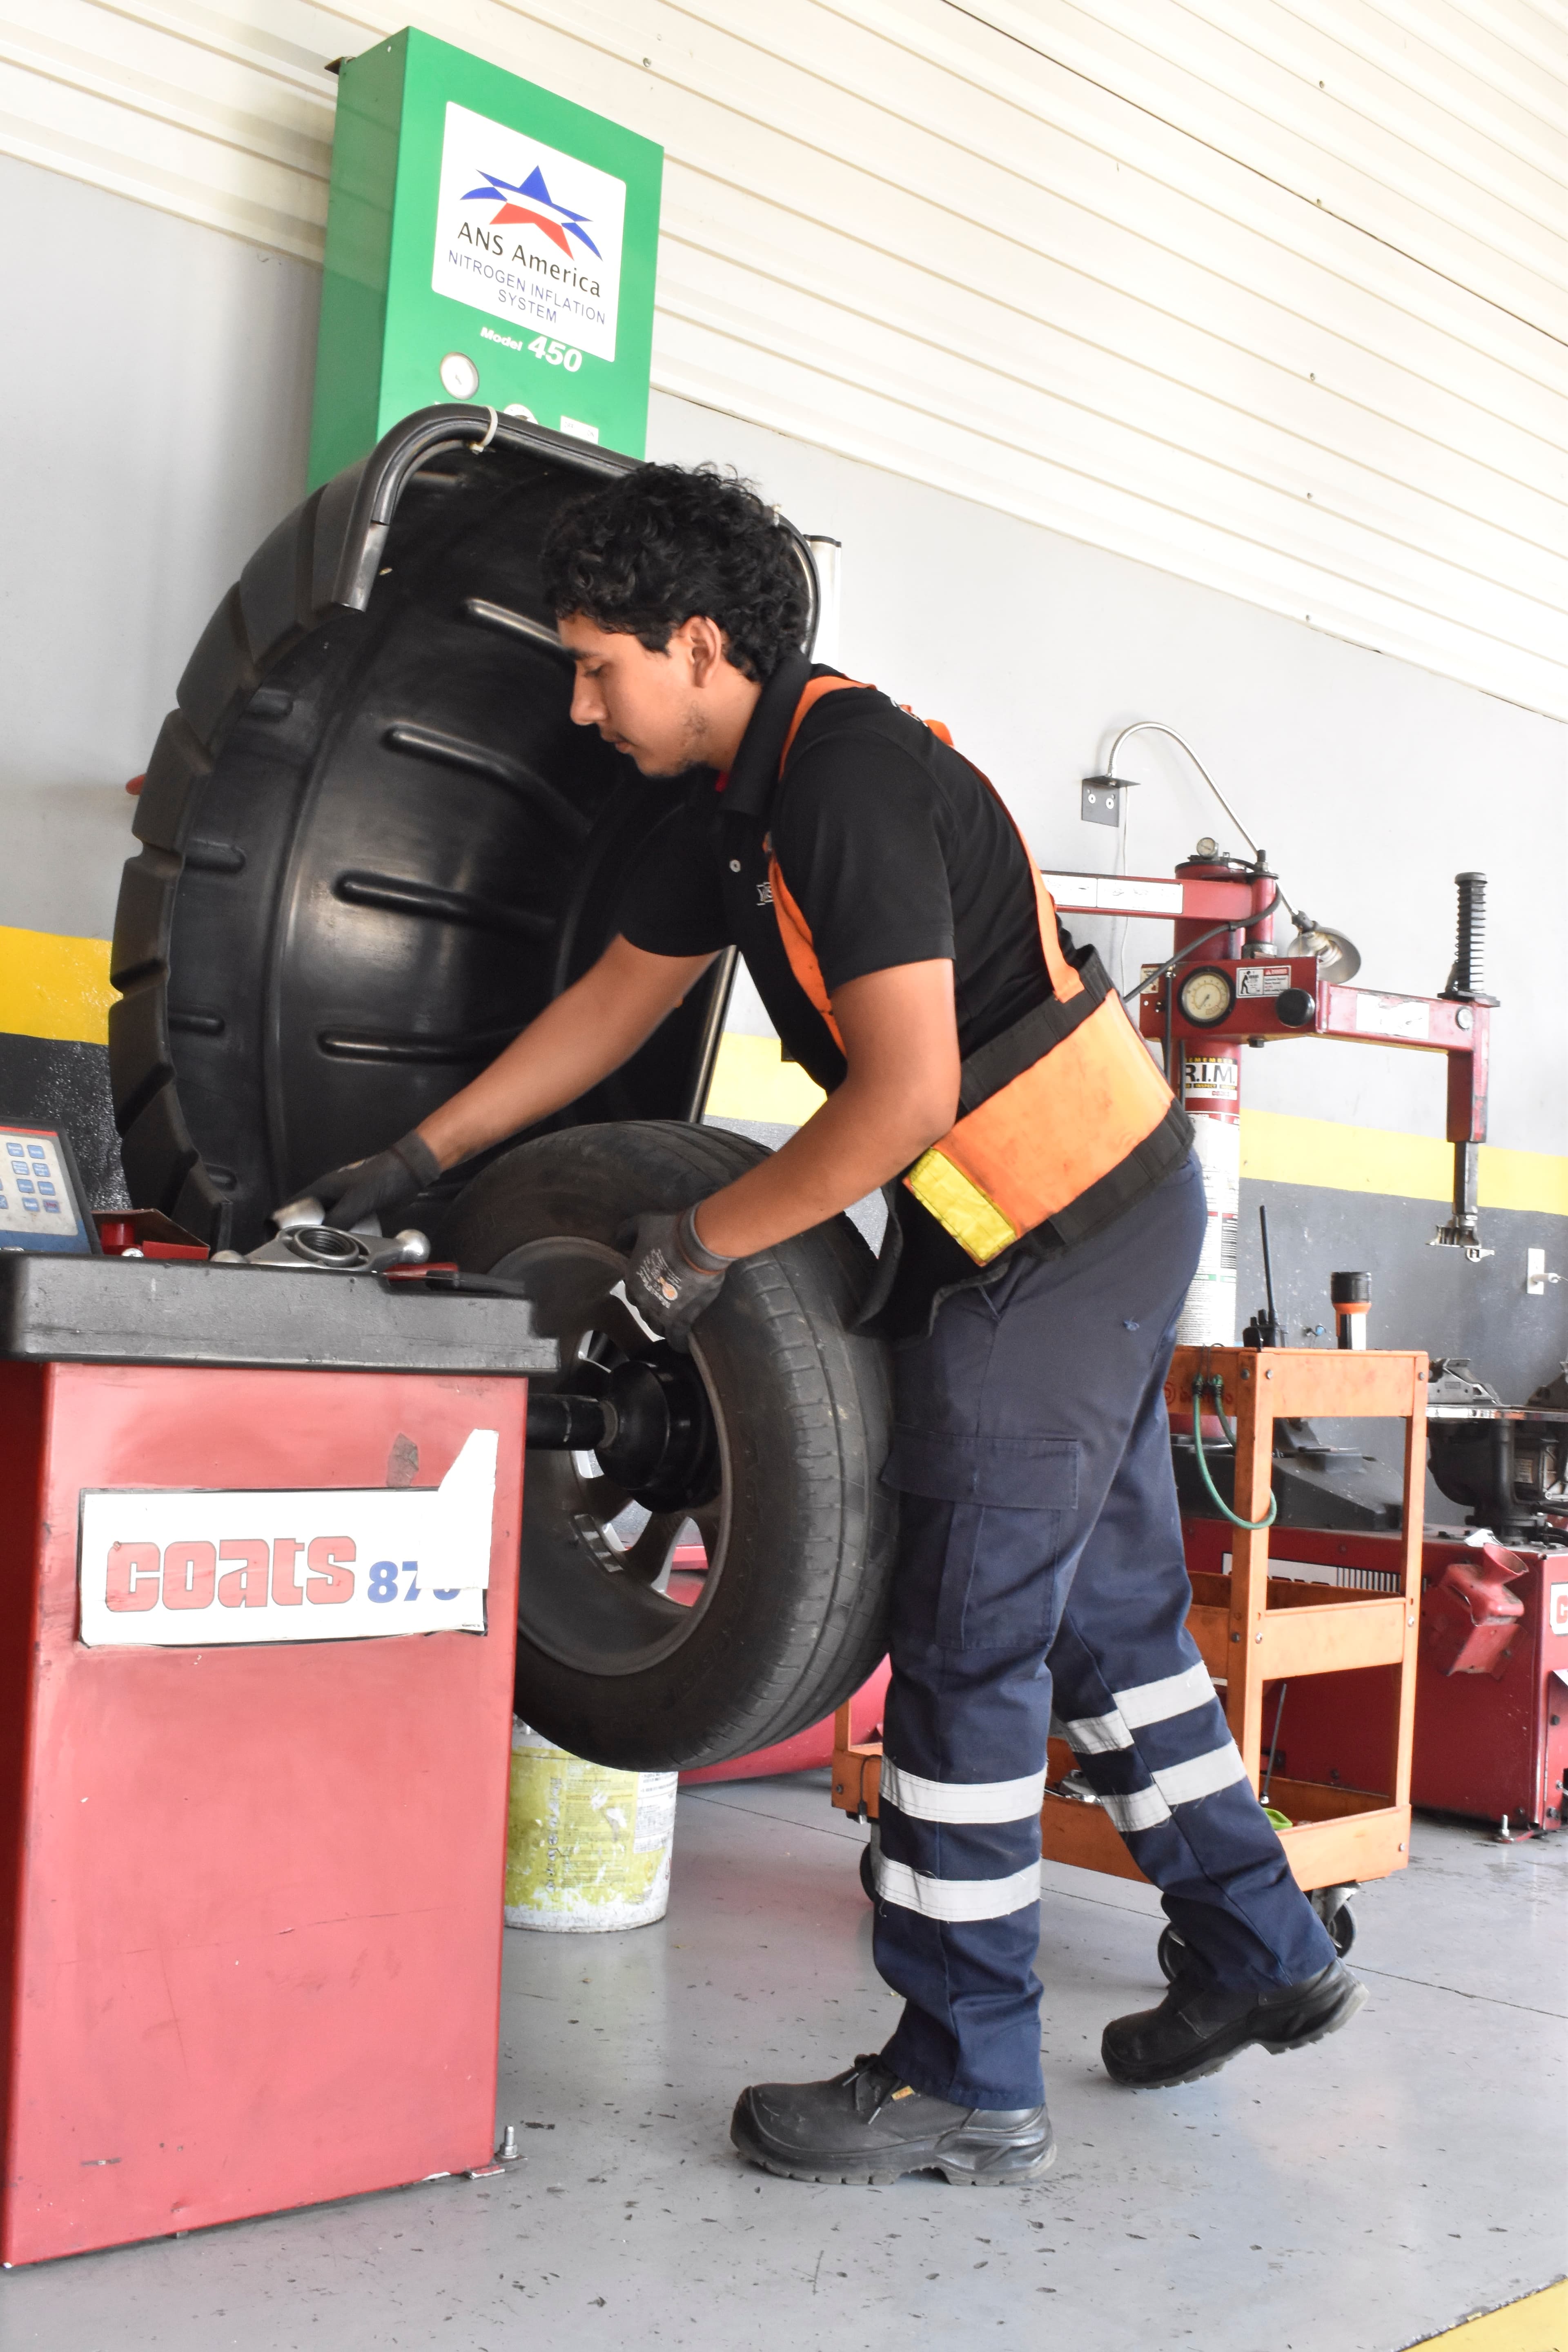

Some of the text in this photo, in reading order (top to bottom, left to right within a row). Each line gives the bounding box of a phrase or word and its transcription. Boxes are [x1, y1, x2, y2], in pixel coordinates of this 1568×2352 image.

[457, 222, 601, 298] ANS America
[448, 249, 605, 325] NITROGEN INFLATION
[498, 289, 557, 323] SYSTEM
[480, 327, 582, 372] Model 450
[1185, 1064, 1235, 1084] R.I.M.
[368, 1561, 461, 1603] 87
